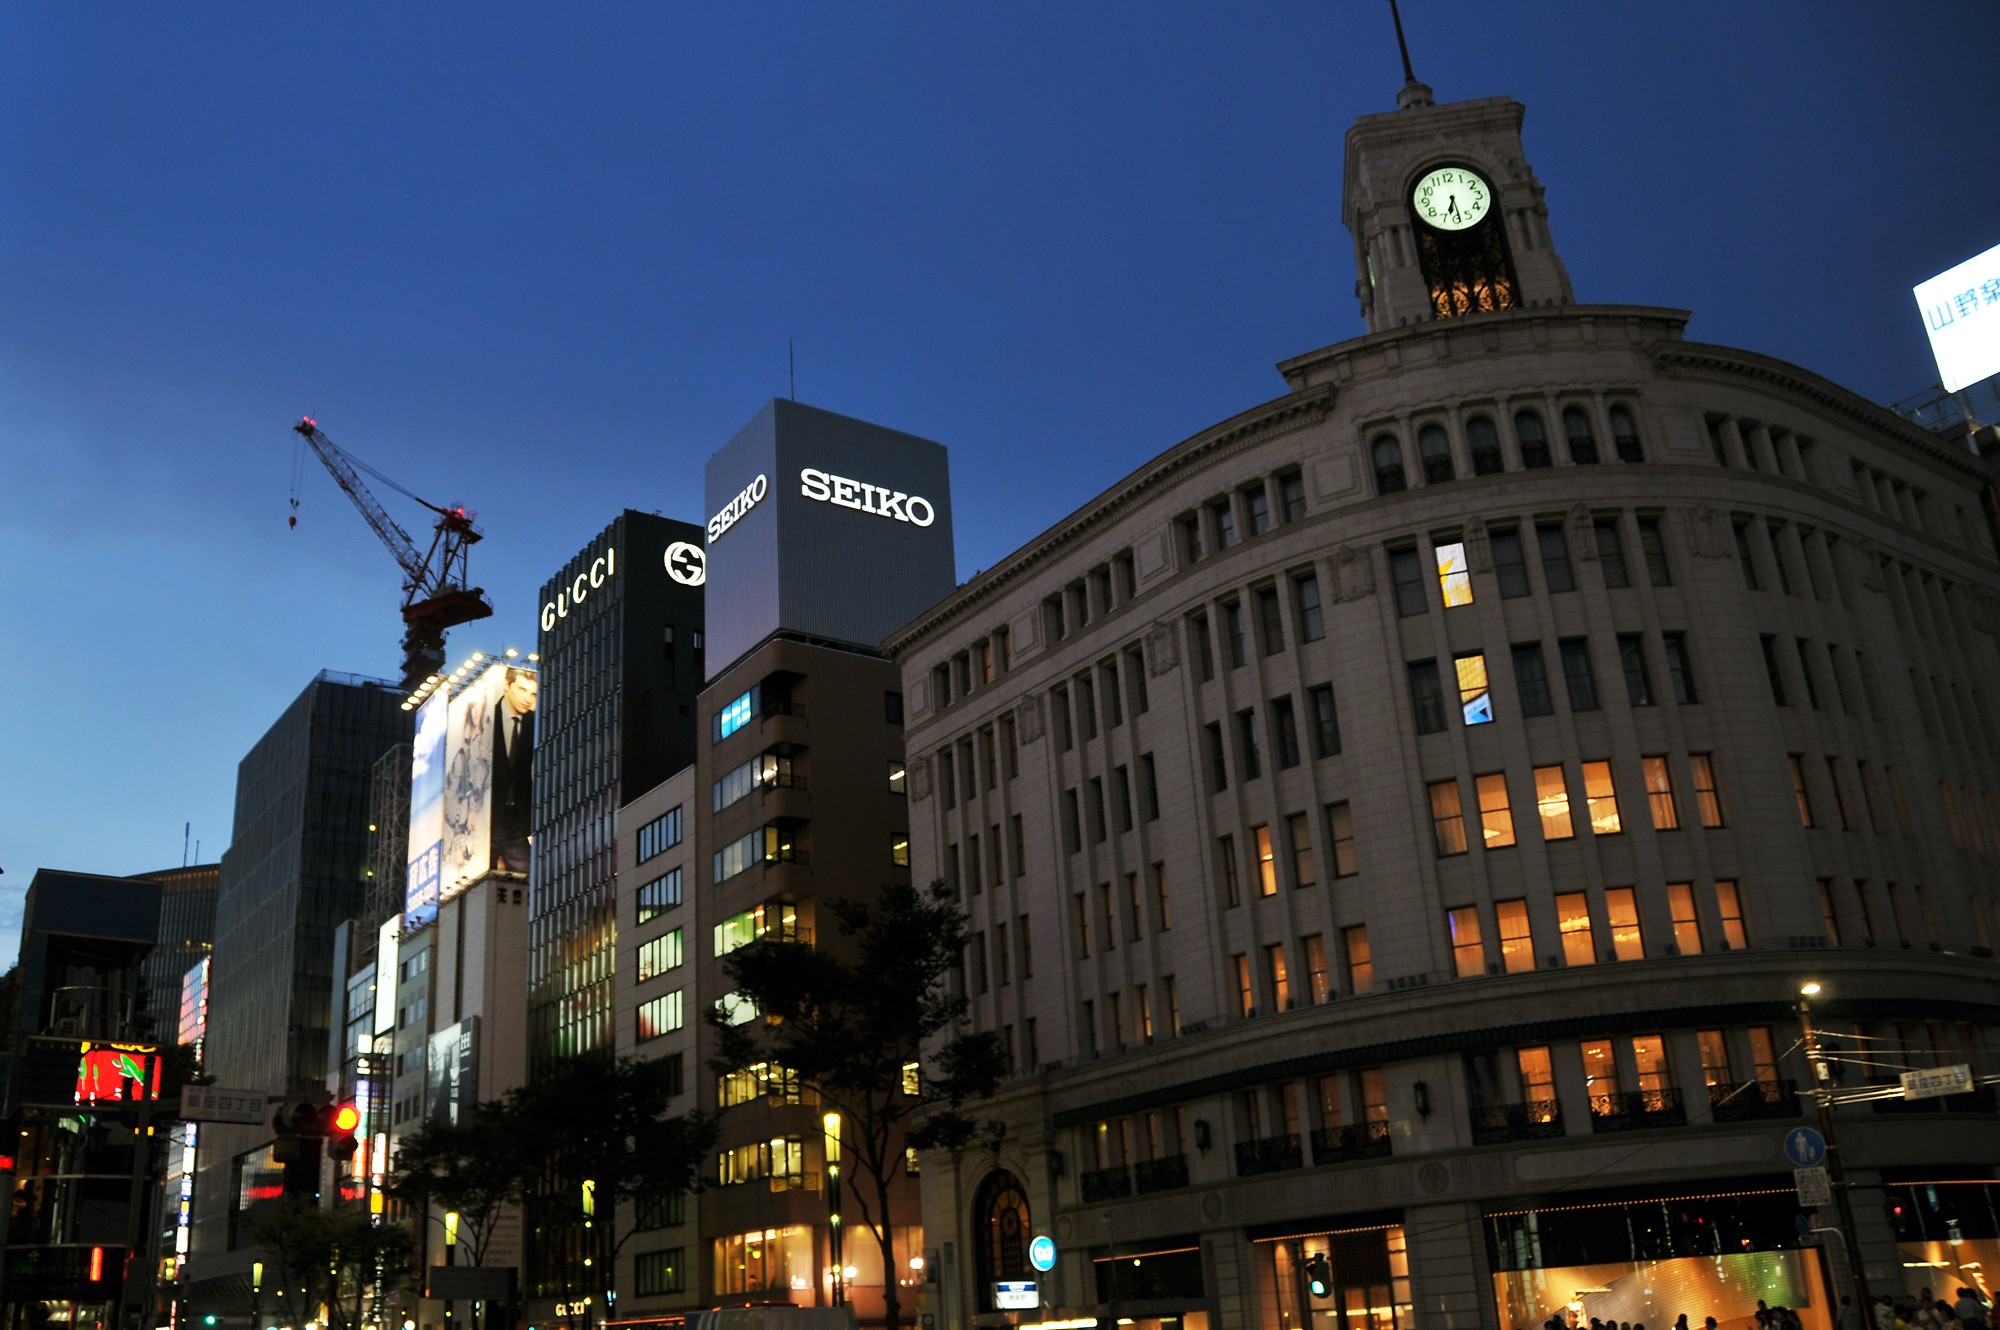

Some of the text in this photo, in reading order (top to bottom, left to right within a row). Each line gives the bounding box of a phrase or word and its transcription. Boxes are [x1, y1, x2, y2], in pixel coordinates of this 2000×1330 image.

[1431, 177, 1441, 187] 11
[1442, 172, 1453, 183] 12
[1468, 180, 1476, 190] 2
[1423, 186, 1433, 196] 10
[1474, 190, 1483, 200] 3
[1421, 197, 1430, 207] 9
[1472, 201, 1481, 211] 4
[1428, 207, 1437, 217] 8
[1464, 210, 1473, 220] 5
[1440, 213, 1448, 223] 7
[801, 468, 936, 528] SEIKO
[707, 473, 768, 544] SEIKO
[541, 547, 616, 632] GUCCI
